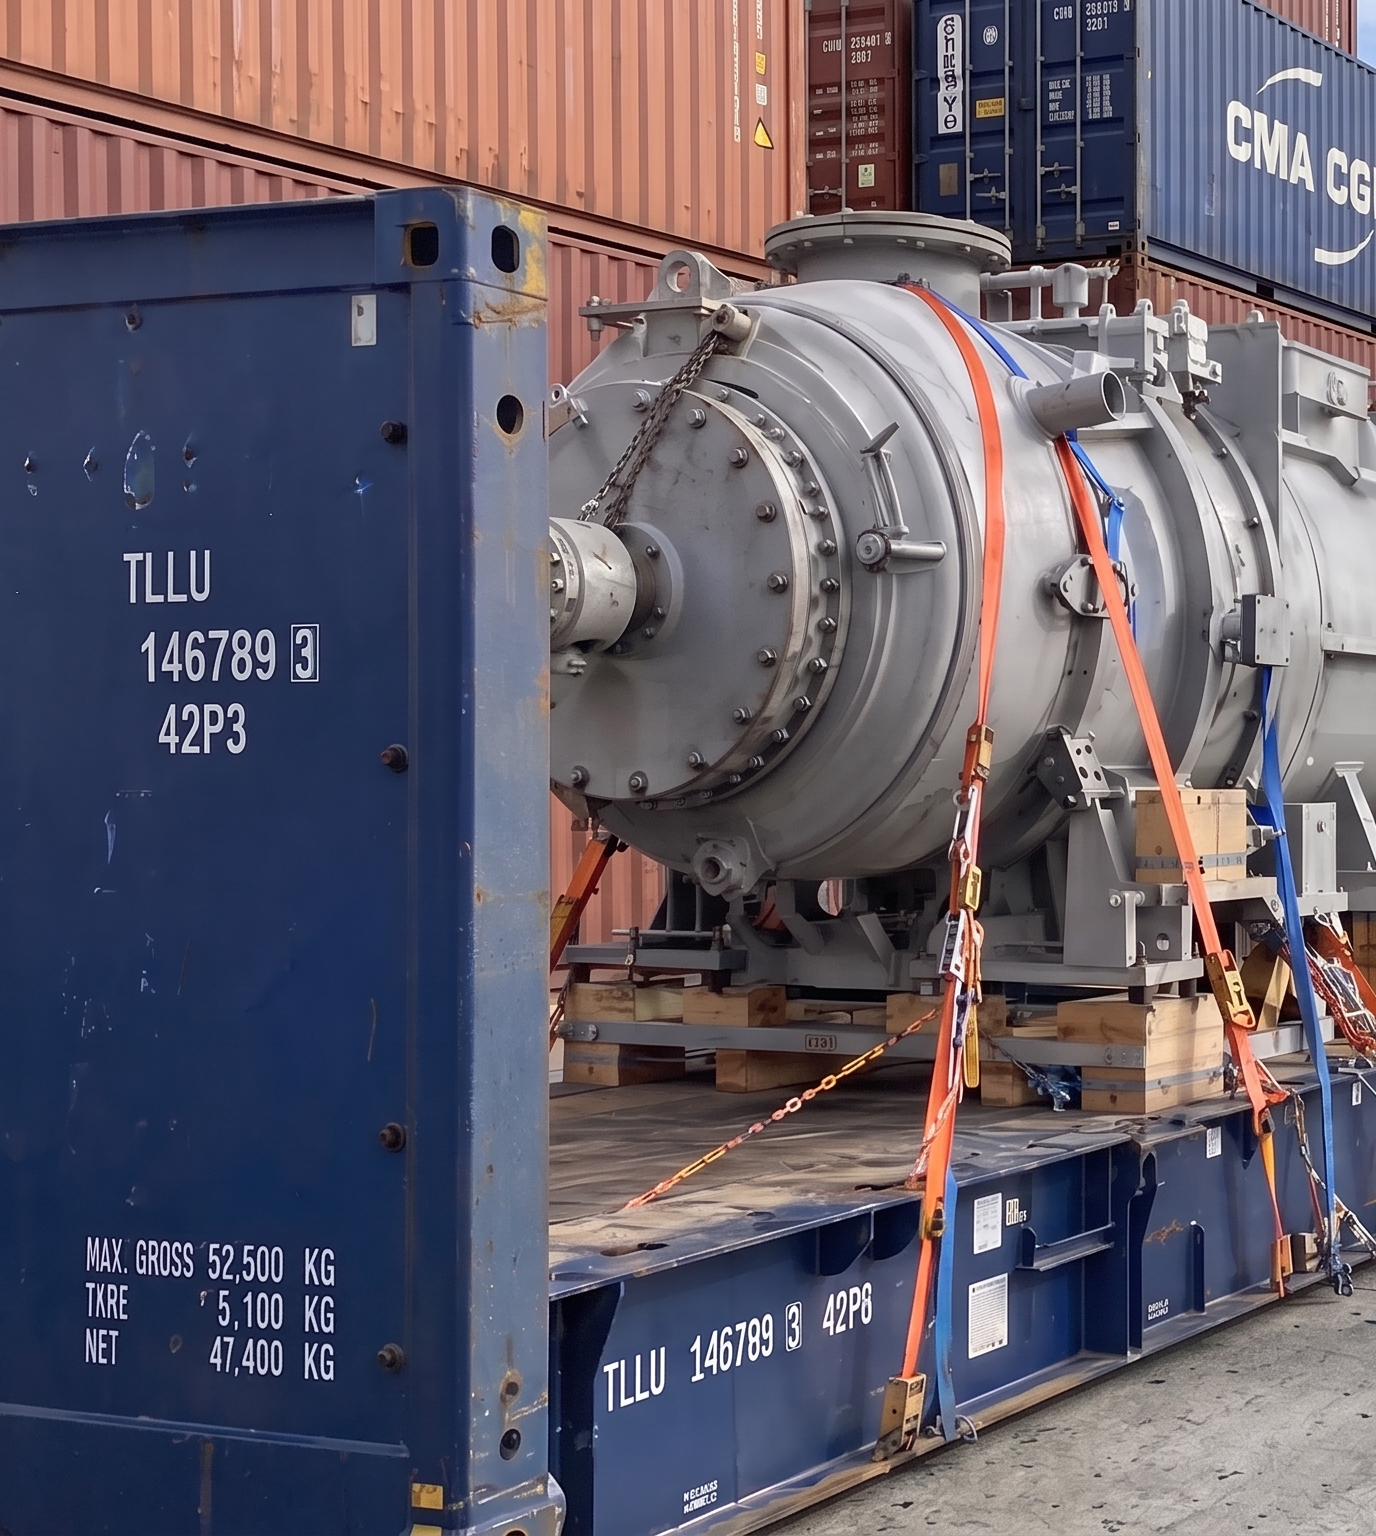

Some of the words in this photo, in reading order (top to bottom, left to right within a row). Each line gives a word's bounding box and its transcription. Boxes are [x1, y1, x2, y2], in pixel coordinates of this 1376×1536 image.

[1227, 100, 1314, 192] CMA
[123, 550, 211, 603] TLLU
[141, 629, 276, 682] 146789
[294, 627, 315, 681] 3
[159, 703, 246, 754] 42P3
[86, 1237, 128, 1275] MAX.
[136, 1239, 194, 1278] GROSS
[208, 1244, 284, 1283] 52,500
[304, 1248, 335, 1287] KG
[218, 1290, 284, 1330] 5,100
[304, 1295, 335, 1334] KG
[85, 1328, 119, 1365] NET
[209, 1337, 284, 1377] 47,400
[304, 1343, 335, 1381] KG
[603, 1346, 666, 1412] TLLU
[690, 1313, 774, 1383] 146789
[787, 1304, 801, 1349] 3
